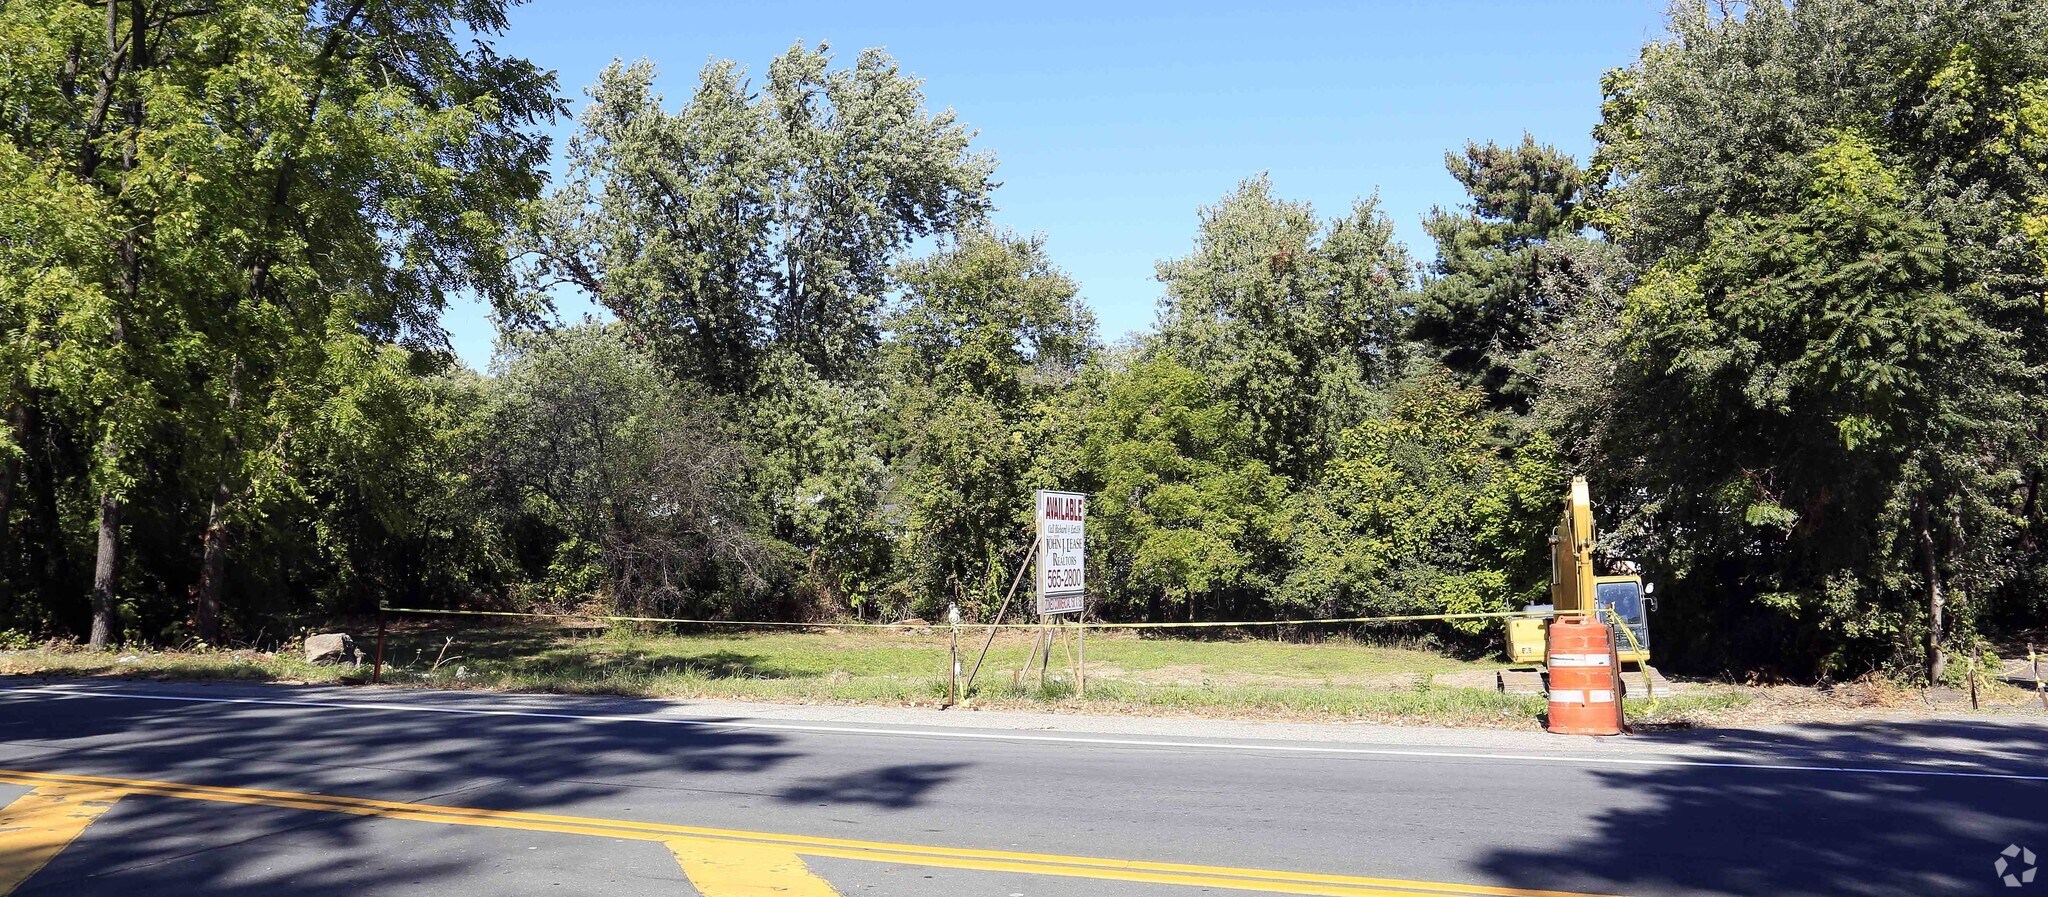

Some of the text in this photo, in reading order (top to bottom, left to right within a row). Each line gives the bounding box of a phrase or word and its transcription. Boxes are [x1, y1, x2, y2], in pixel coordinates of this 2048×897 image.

[1045, 496, 1083, 522] AVAILABLE
[1045, 538, 1061, 557] JOHN
[1066, 538, 1082, 553] LEASE
[1052, 552, 1077, 567] REALTORS
[1047, 568, 1082, 589] 565-2800
